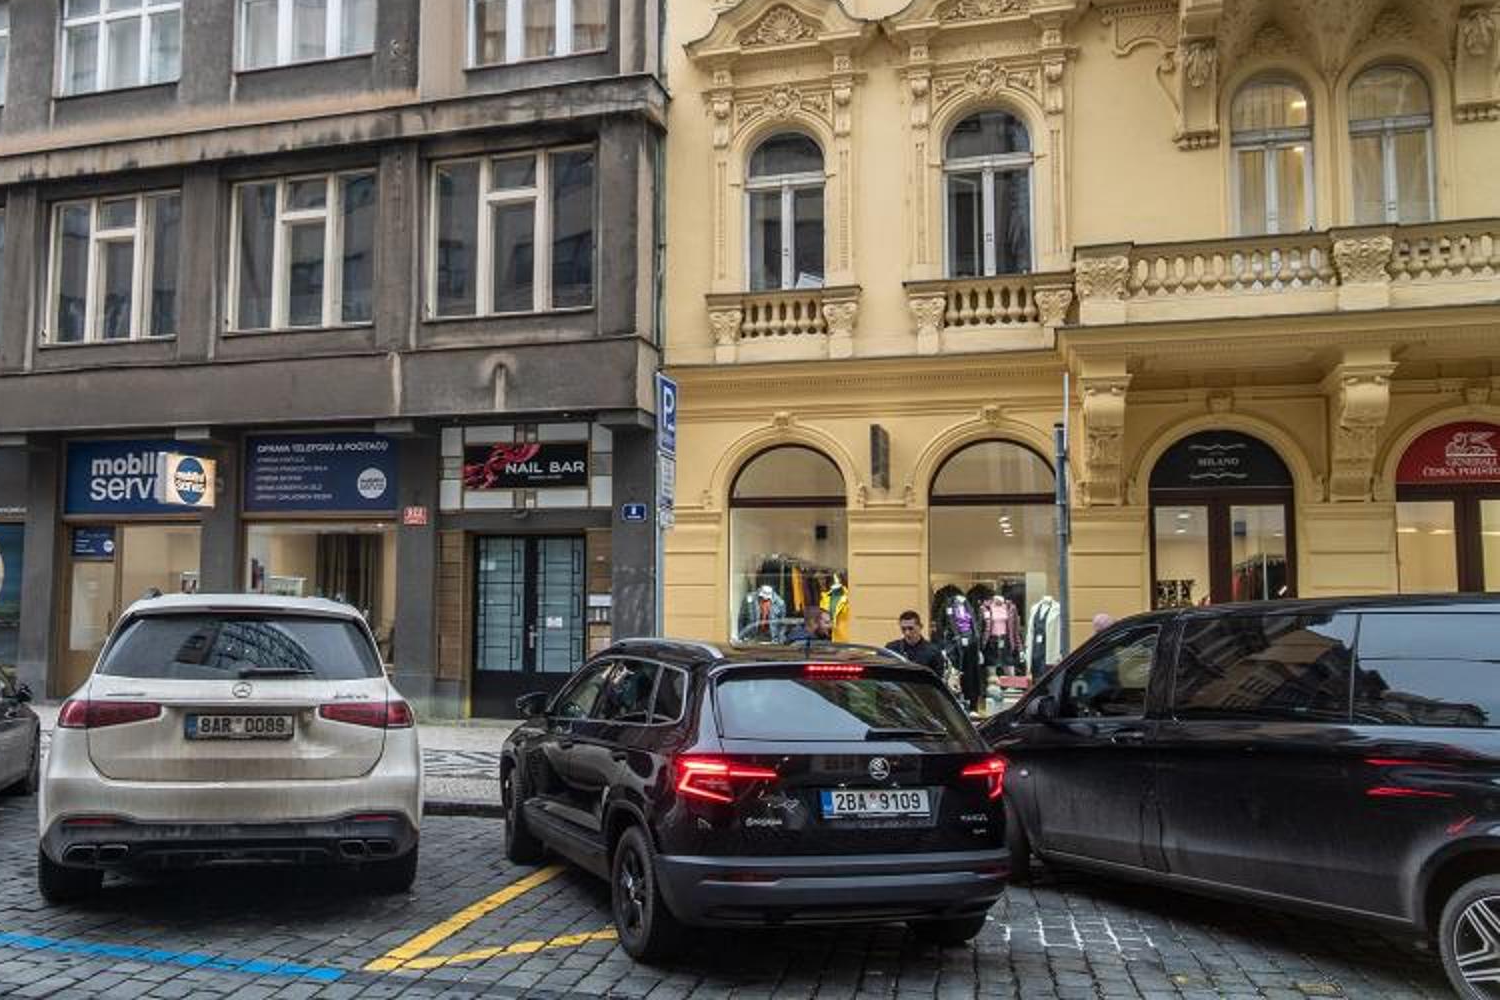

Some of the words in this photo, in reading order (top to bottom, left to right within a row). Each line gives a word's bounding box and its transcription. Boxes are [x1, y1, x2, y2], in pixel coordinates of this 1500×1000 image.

[90, 452, 156, 476] mobil
[505, 461, 544, 474] NAIL
[549, 461, 586, 473] BAR
[201, 717, 232, 733] 8AR
[835, 793, 867, 811] 2BA
[879, 793, 921, 810] 9109
